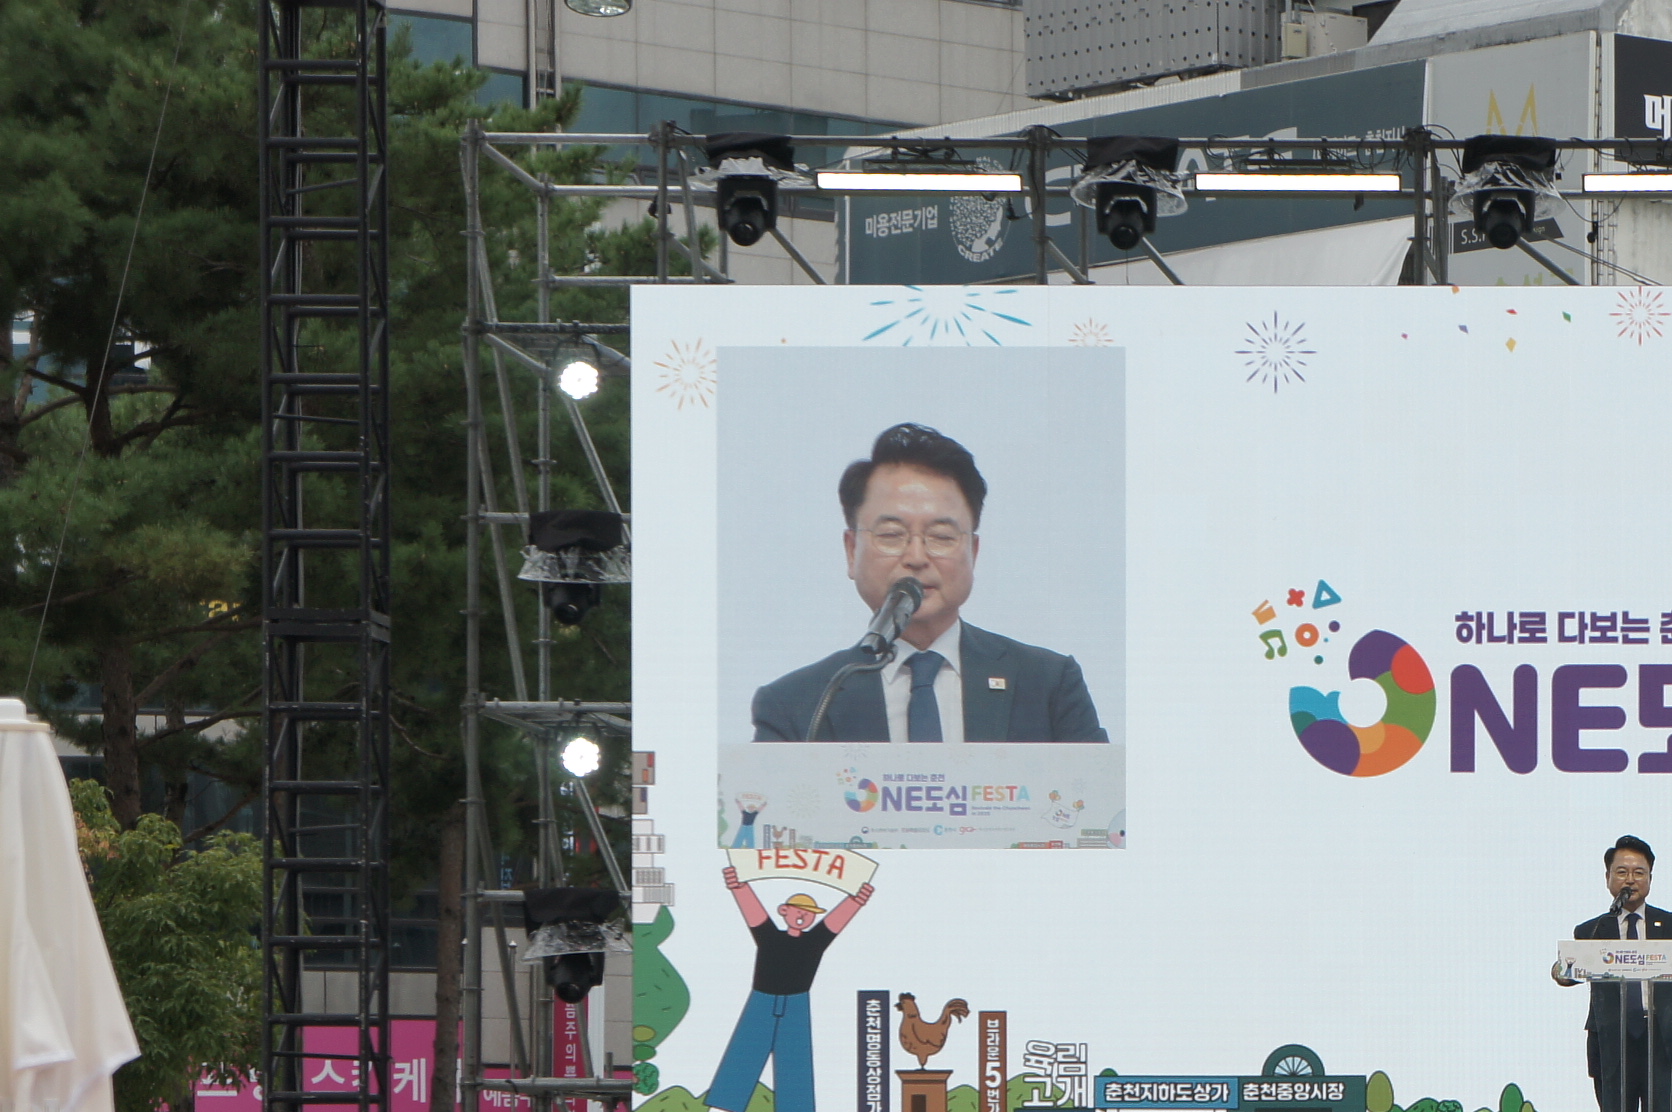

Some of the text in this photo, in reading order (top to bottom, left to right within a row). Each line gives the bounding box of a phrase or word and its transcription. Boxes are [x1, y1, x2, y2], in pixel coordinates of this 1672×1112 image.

[865, 205, 938, 238] 미용전문기업
[1455, 610, 1548, 645] 하나로
[1557, 610, 1651, 645] 다보는
[971, 785, 1031, 801] FESTA
[757, 849, 846, 879] FESTA
[1023, 1040, 1089, 1077] 육림
[1023, 1073, 1088, 1110] 고개
[1104, 1083, 1231, 1103] 춘천지하도상가
[1242, 1082, 1346, 1102] 춘천중앙시장
